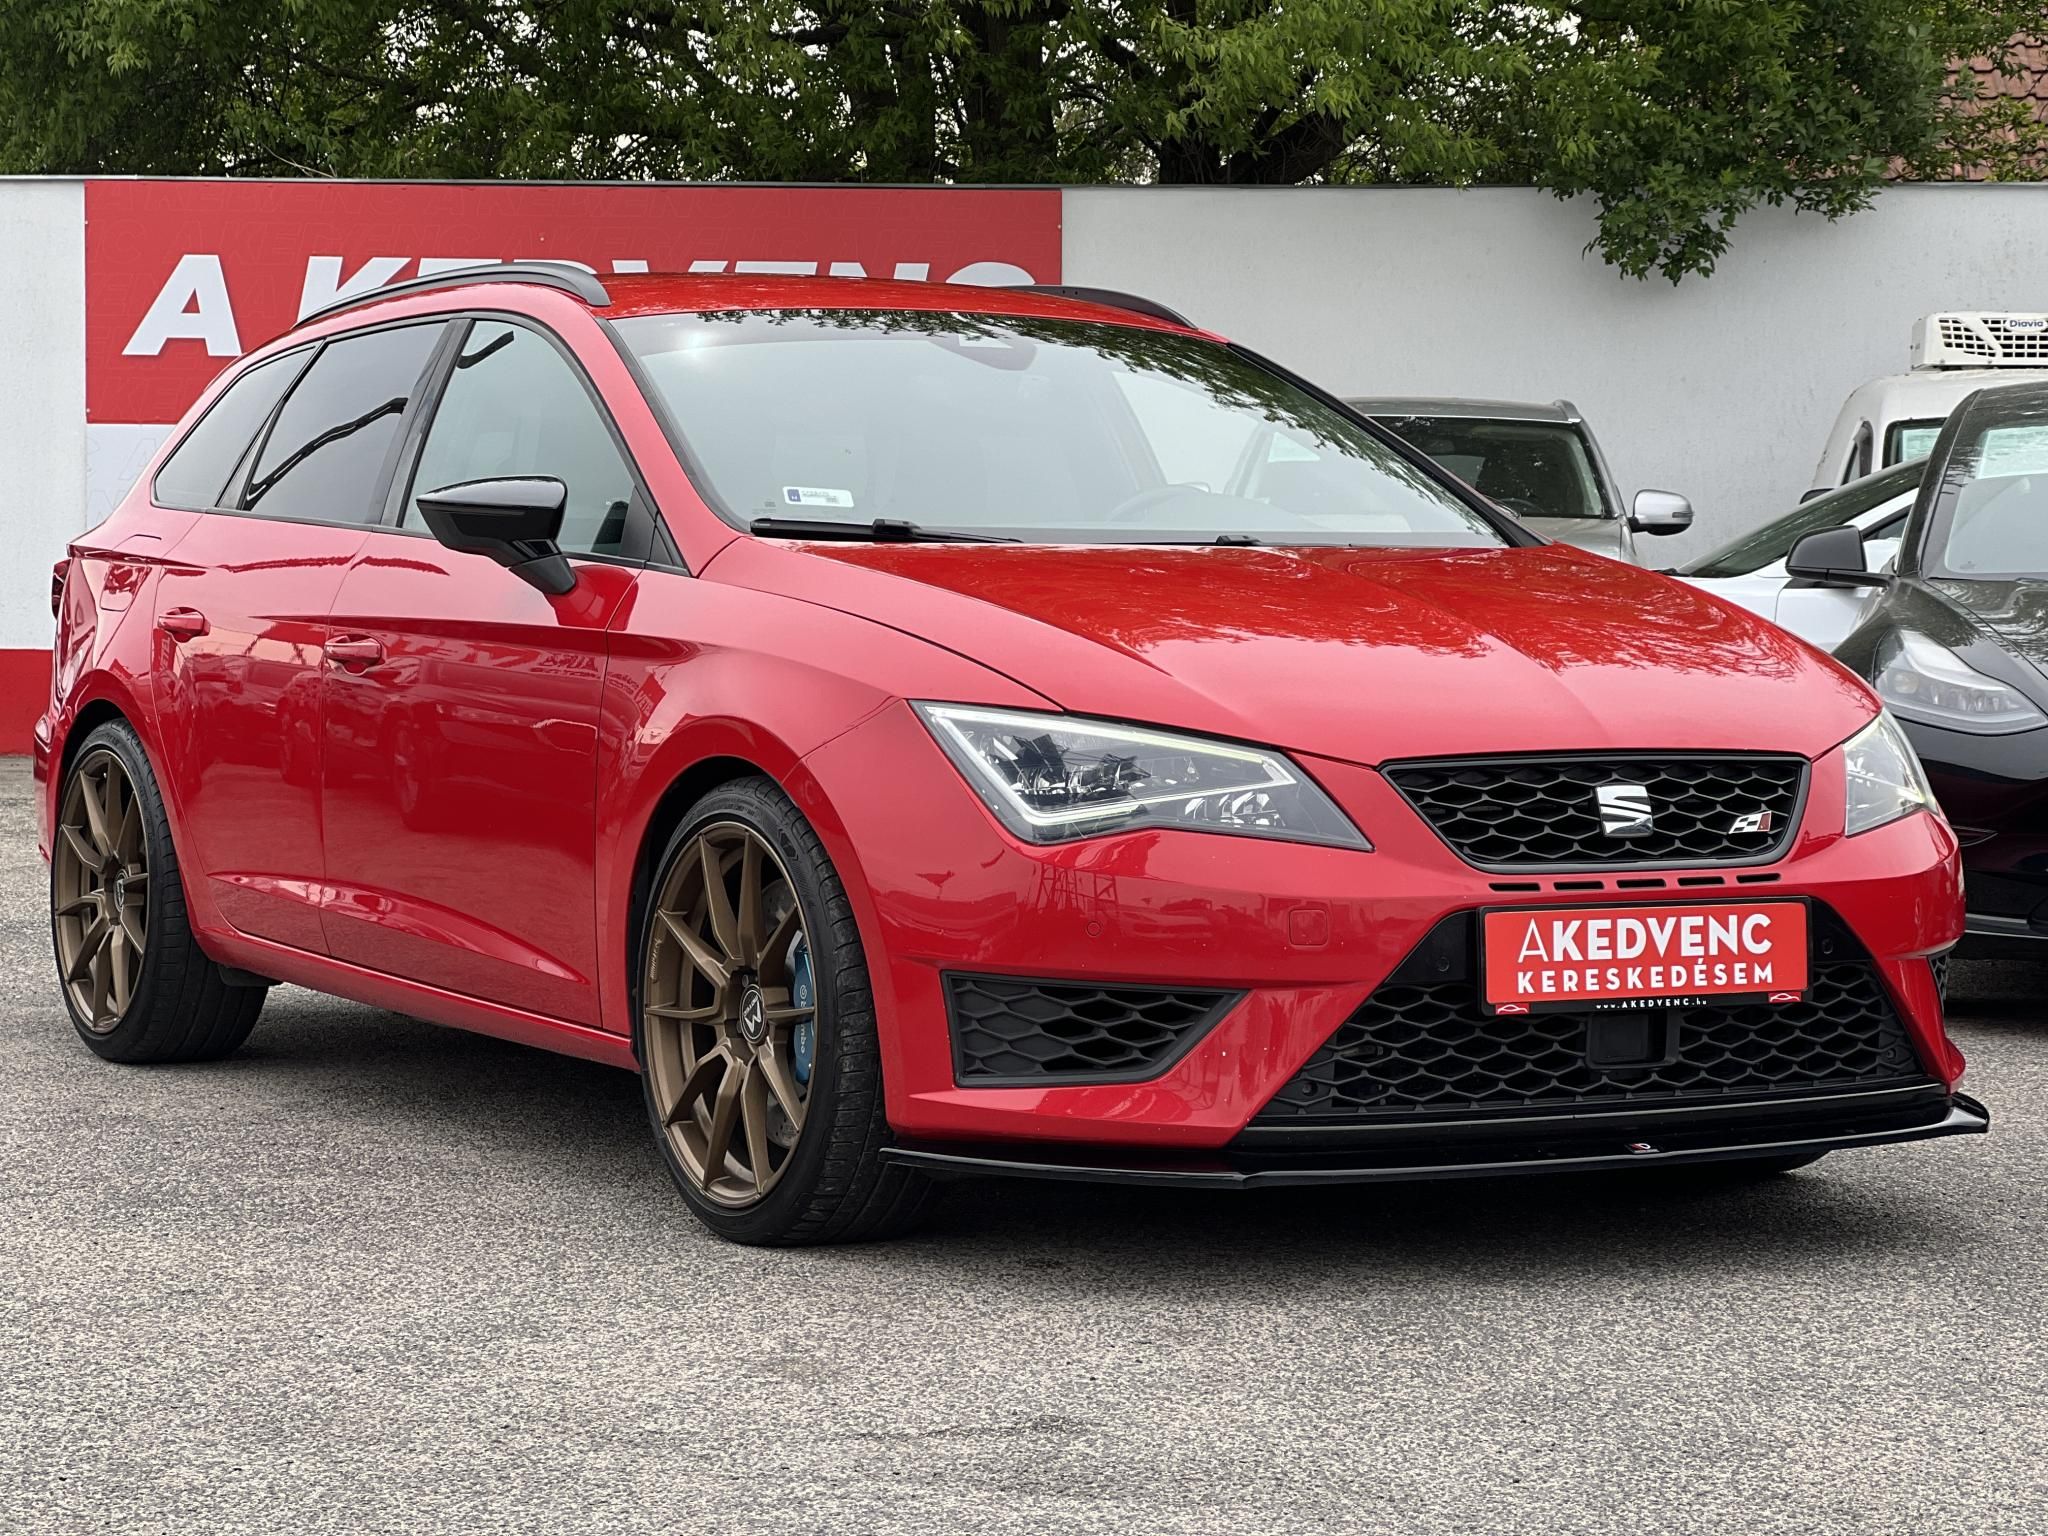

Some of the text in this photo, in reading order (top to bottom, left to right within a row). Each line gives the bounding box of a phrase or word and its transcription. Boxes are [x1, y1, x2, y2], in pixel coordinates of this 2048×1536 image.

[121, 254, 243, 356] A
[2009, 319, 2044, 327] Diavia
[1517, 958, 1774, 994] KERESKEDÉSEM
